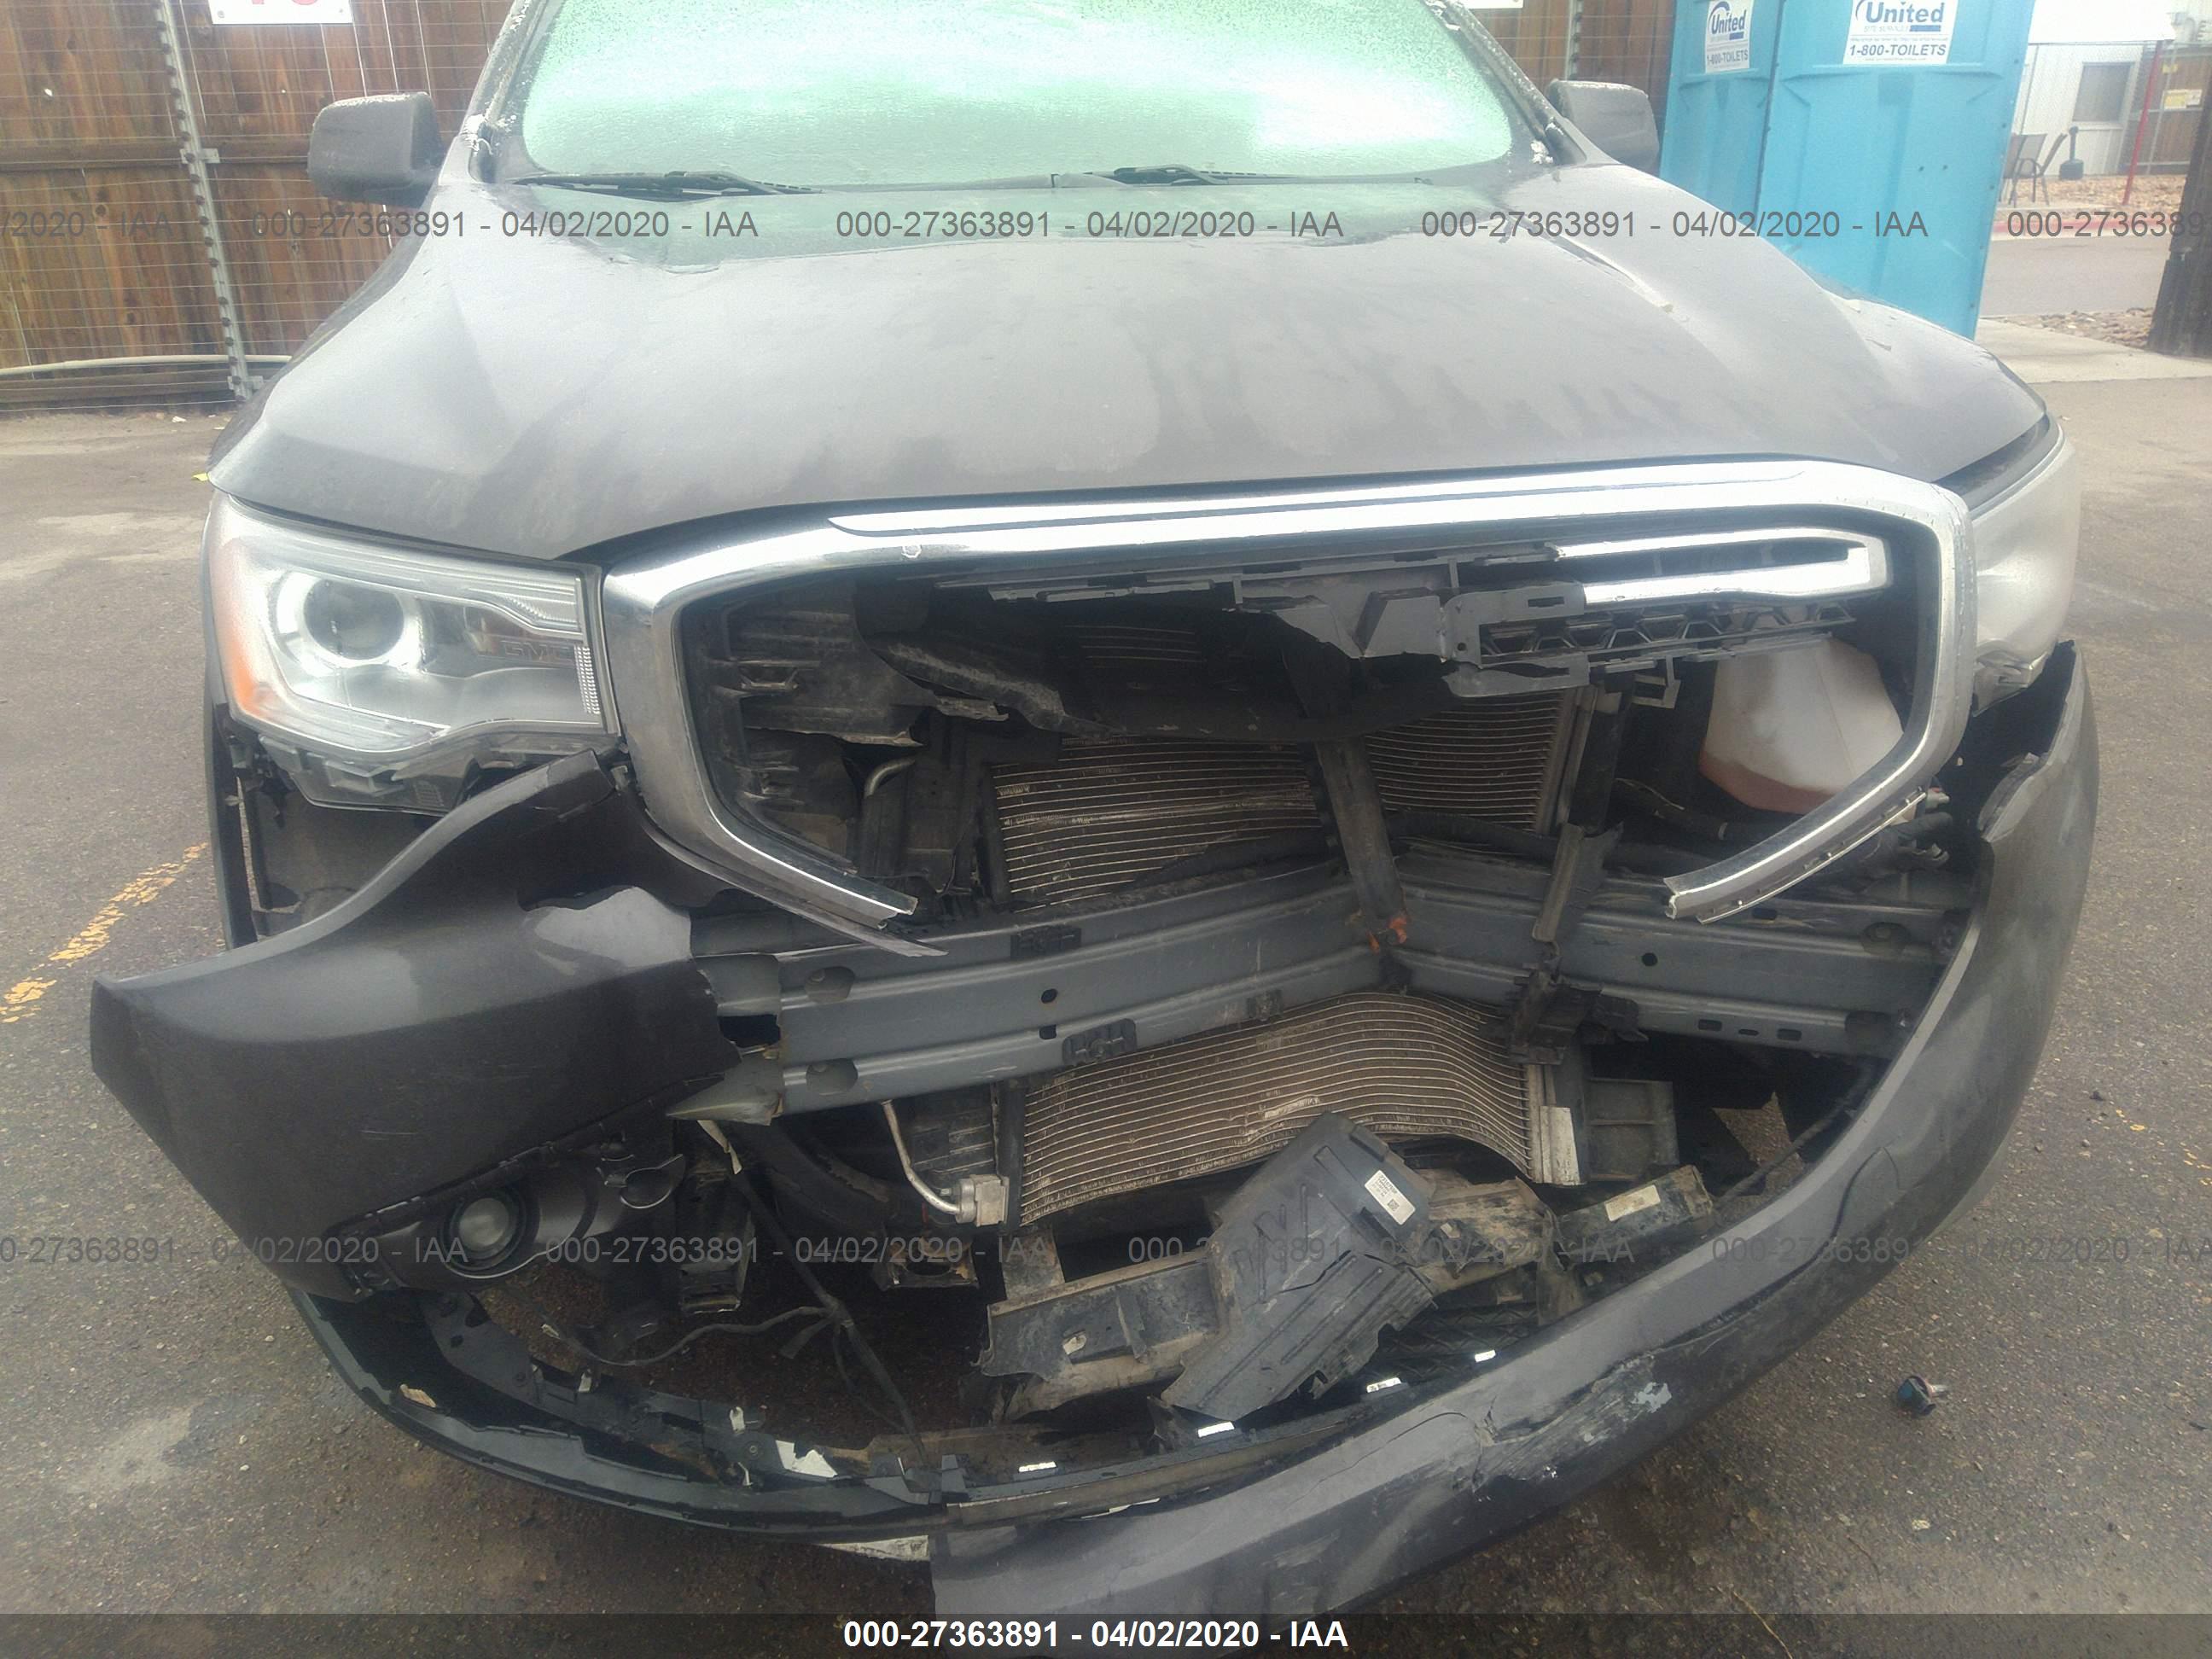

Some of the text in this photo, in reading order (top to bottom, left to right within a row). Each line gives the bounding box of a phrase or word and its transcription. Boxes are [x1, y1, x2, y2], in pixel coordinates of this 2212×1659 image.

[1711, 9, 1746, 34] United
[1866, 1, 1945, 23] United
[1850, 44, 1947, 56] 1-800-TOILETS
